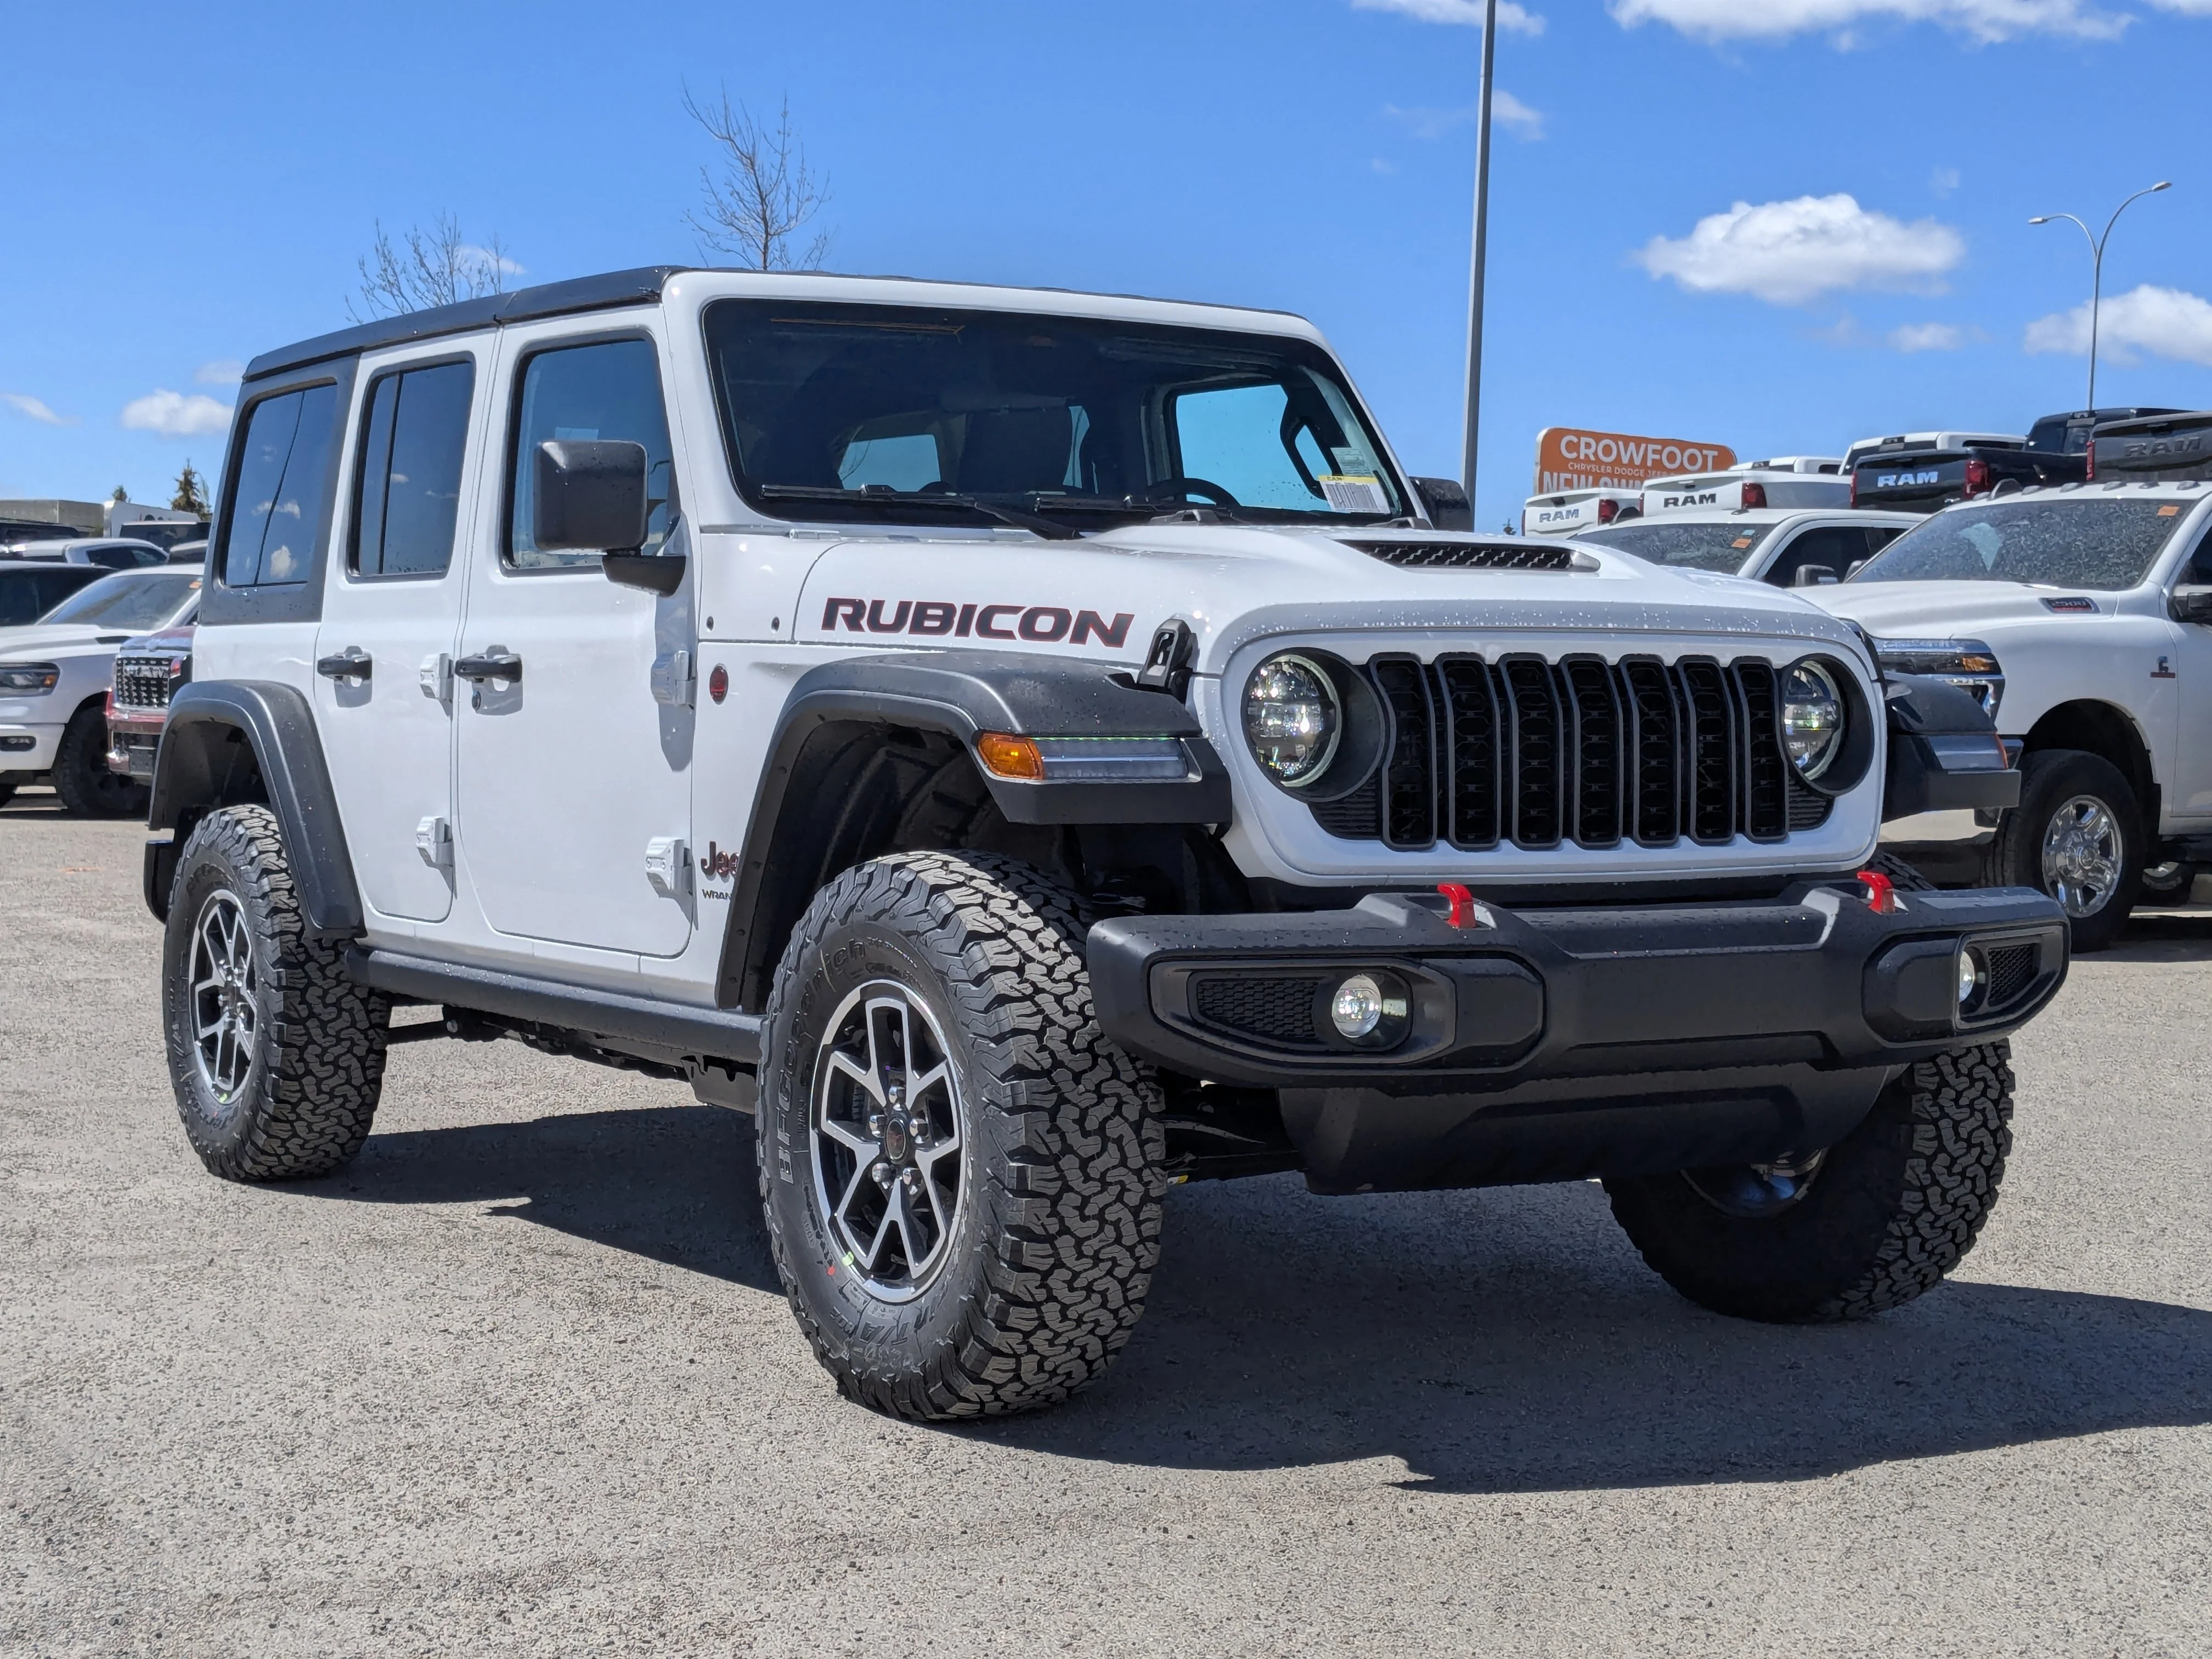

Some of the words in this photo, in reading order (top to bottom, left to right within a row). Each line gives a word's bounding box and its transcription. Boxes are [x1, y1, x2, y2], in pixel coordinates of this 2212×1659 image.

[1560, 435, 1718, 472] CROWFOOT
[1568, 462, 1612, 474] CHRYSLER
[1614, 467, 1645, 477] DODGE
[1877, 471, 1938, 488] RAM
[1663, 494, 1717, 508] RAM
[1539, 509, 1579, 523] RAM
[821, 597, 1135, 648] RUBICON
